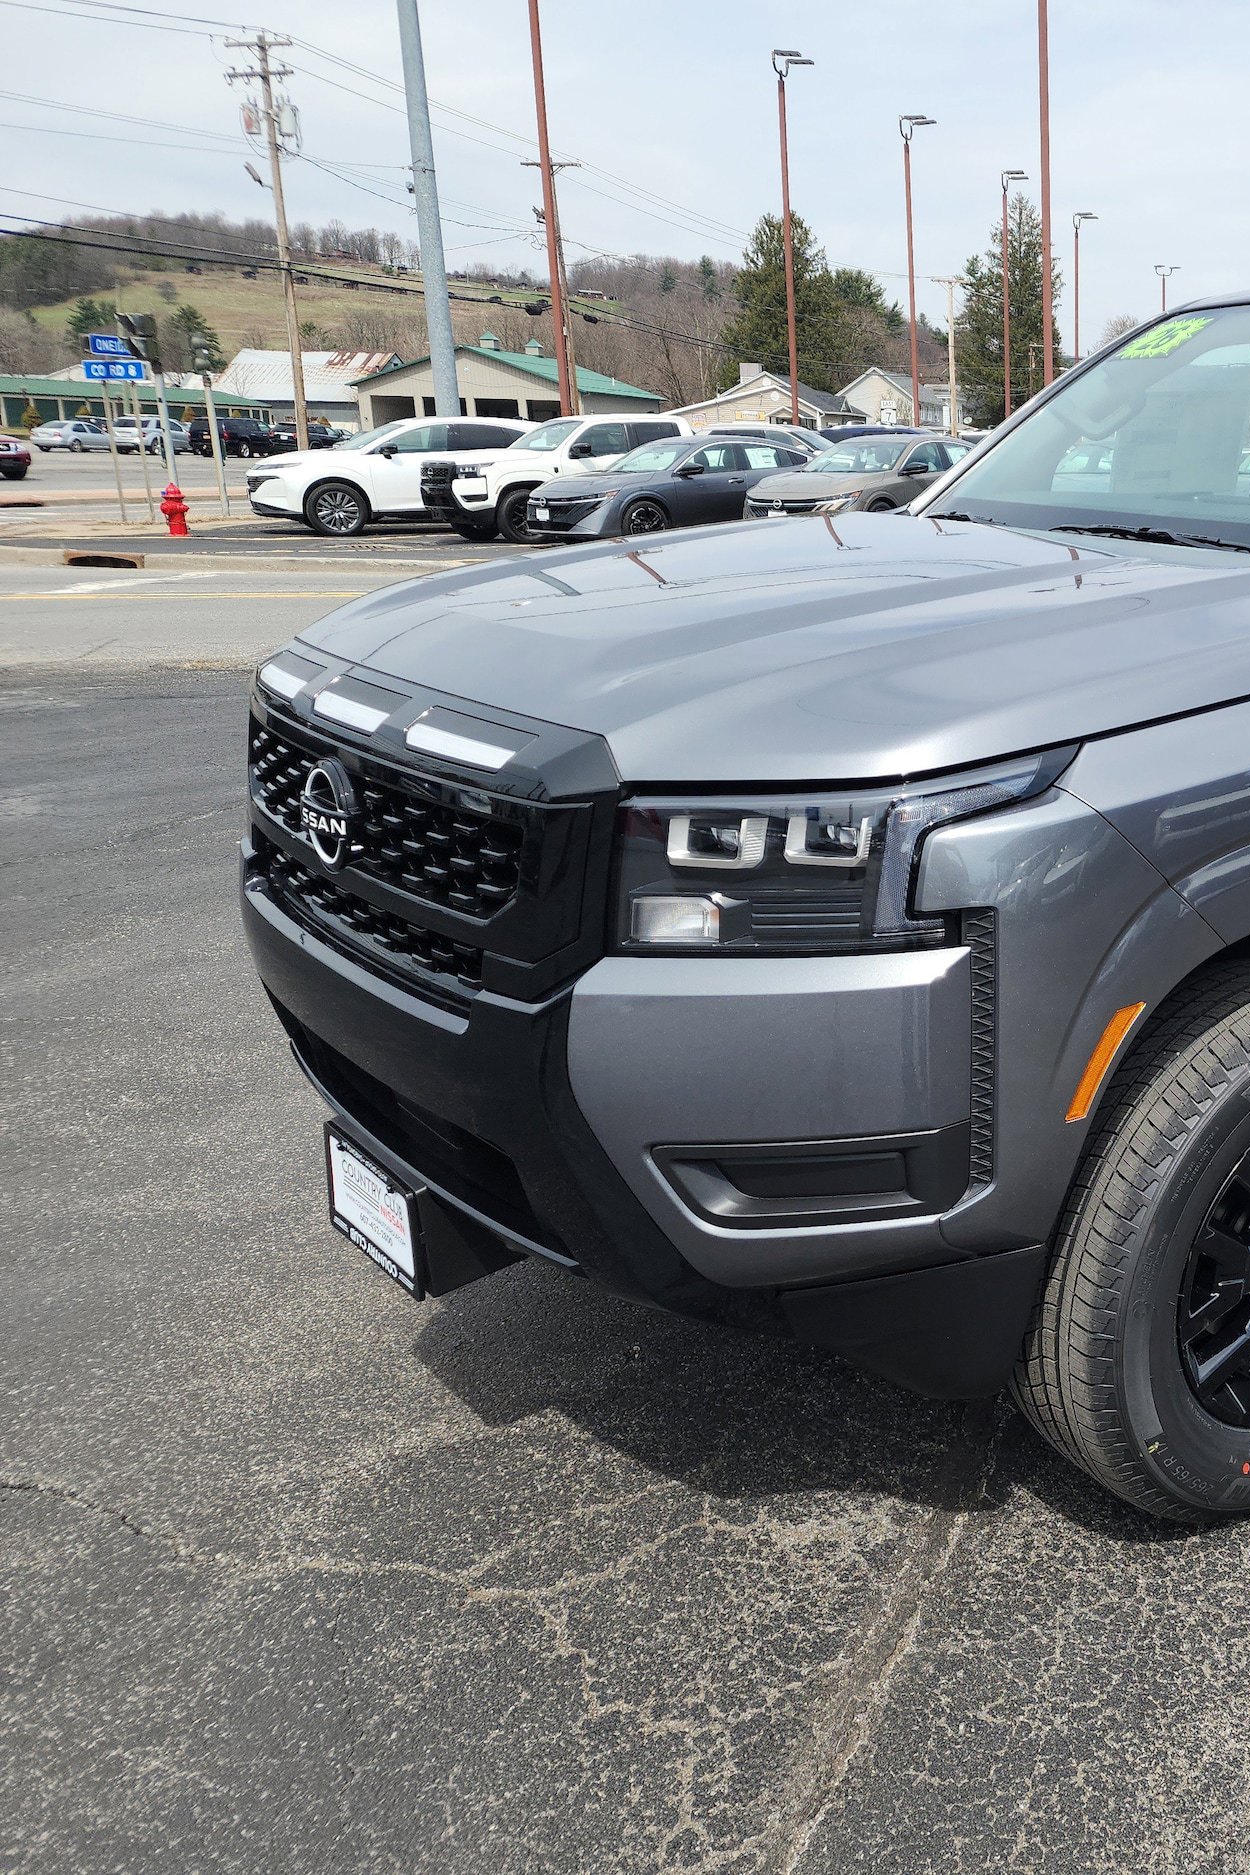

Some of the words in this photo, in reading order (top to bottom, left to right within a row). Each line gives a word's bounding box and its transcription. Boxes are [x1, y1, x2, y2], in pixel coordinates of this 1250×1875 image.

[96, 338, 129, 352] ONEI
[90, 364, 106, 377] CO
[109, 364, 125, 377] RD
[885, 412, 892, 421] 7
[302, 807, 347, 835] SSAN
[341, 1159, 381, 1199] COUNTRY
[384, 1192, 404, 1221] CLUB
[380, 1204, 405, 1236] NISSAN
[349, 1227, 368, 1251] CLUB
[366, 1245, 399, 1278] COUNTRY
[1163, 1456, 1177, 1468] R
[1171, 1465, 1215, 1496] 265/65
